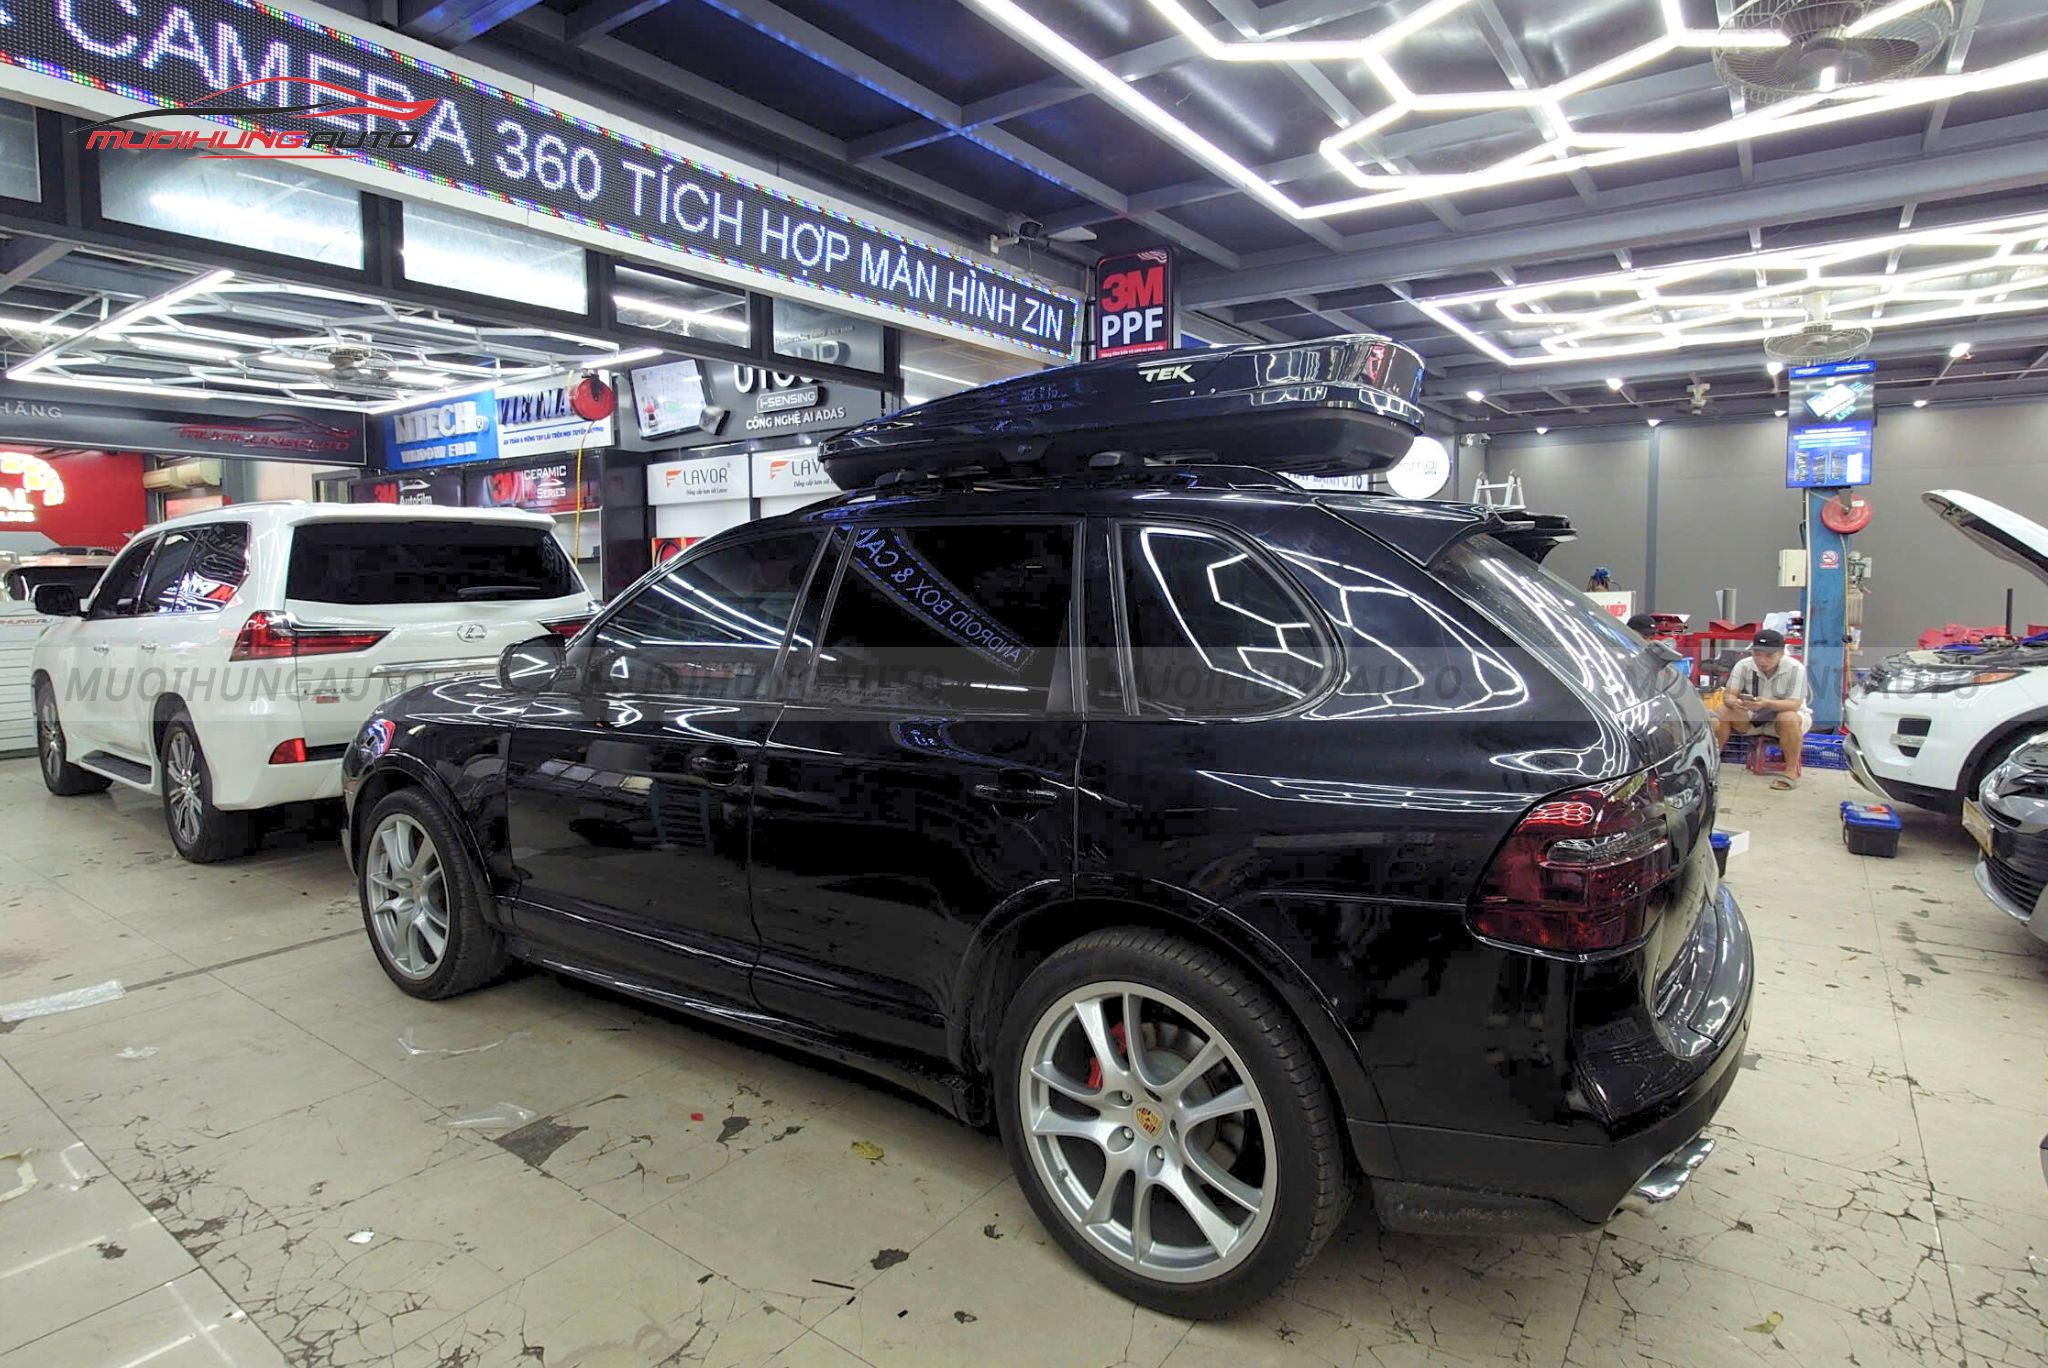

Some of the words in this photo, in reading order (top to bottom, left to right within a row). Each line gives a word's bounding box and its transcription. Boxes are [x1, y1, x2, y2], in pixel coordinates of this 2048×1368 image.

[497, 121, 604, 202] 360
[621, 158, 744, 246] TÍCH
[759, 208, 850, 276] HỢP
[859, 242, 938, 304] MÀN
[945, 269, 1016, 328] HÌNH
[1020, 296, 1065, 343] ZIN
[1101, 266, 1165, 313] 3M
[1101, 307, 1164, 349] PPF
[1137, 363, 1197, 384] TEK
[498, 388, 574, 426] VIETMA
[746, 416, 773, 431] CÔNG
[775, 411, 801, 428] NGHỆ
[803, 413, 814, 424] AI
[815, 406, 846, 422] ADAS
[524, 465, 567, 480] CERAMIC
[683, 467, 728, 486] LAVOR
[791, 456, 827, 476] LAV
[537, 486, 567, 498] SERIES
